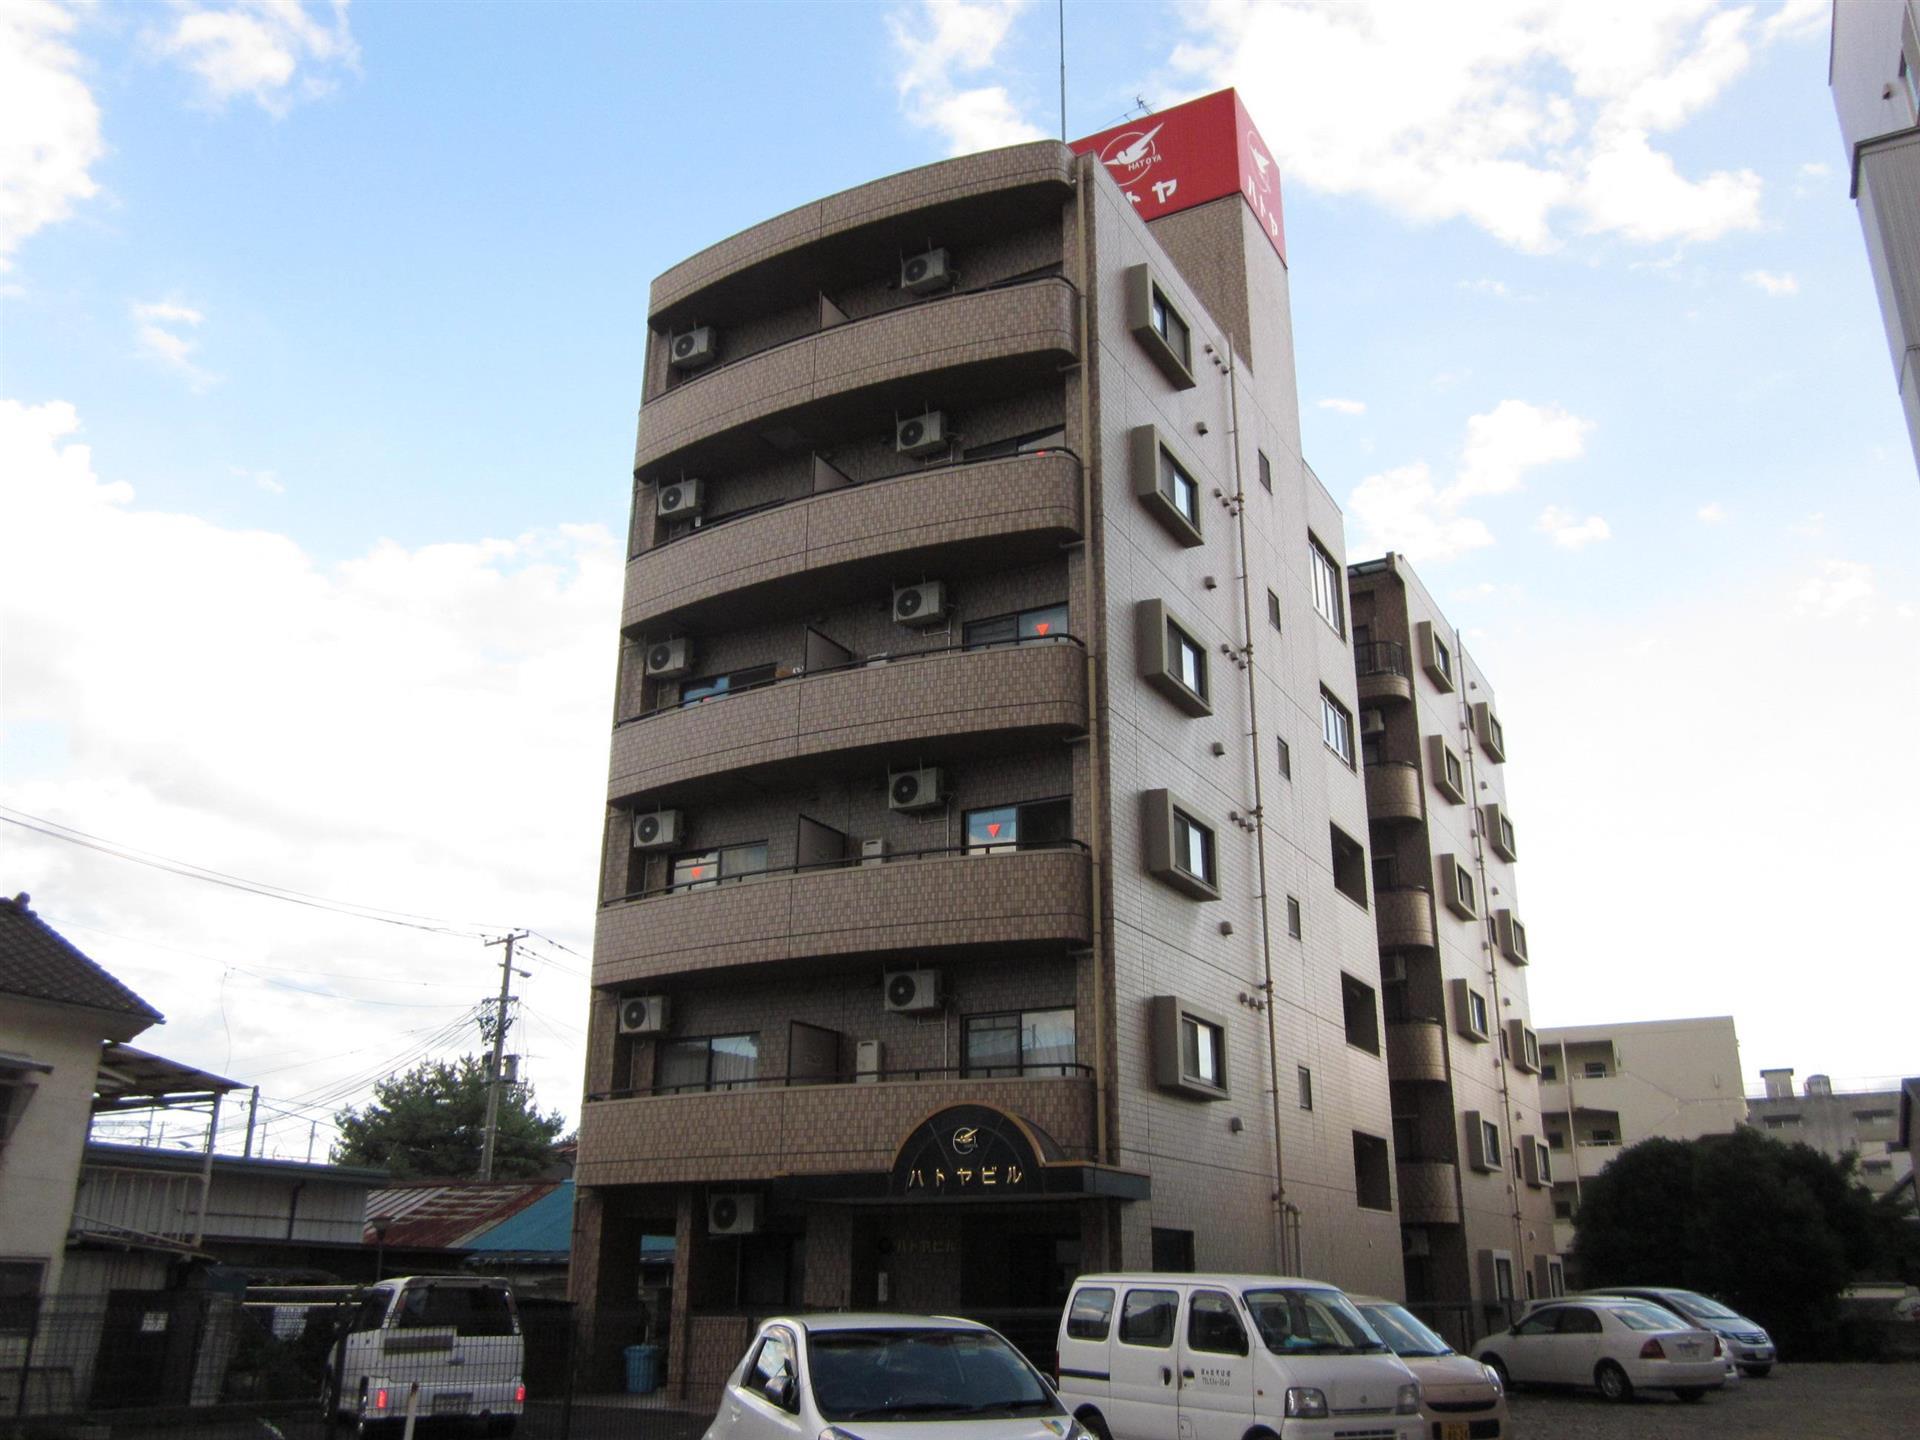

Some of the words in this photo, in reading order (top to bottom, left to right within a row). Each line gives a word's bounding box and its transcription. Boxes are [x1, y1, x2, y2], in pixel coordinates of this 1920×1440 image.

[1128, 154, 1162, 171] HATOYA
[908, 1166, 1022, 1187] ハトヤビル
